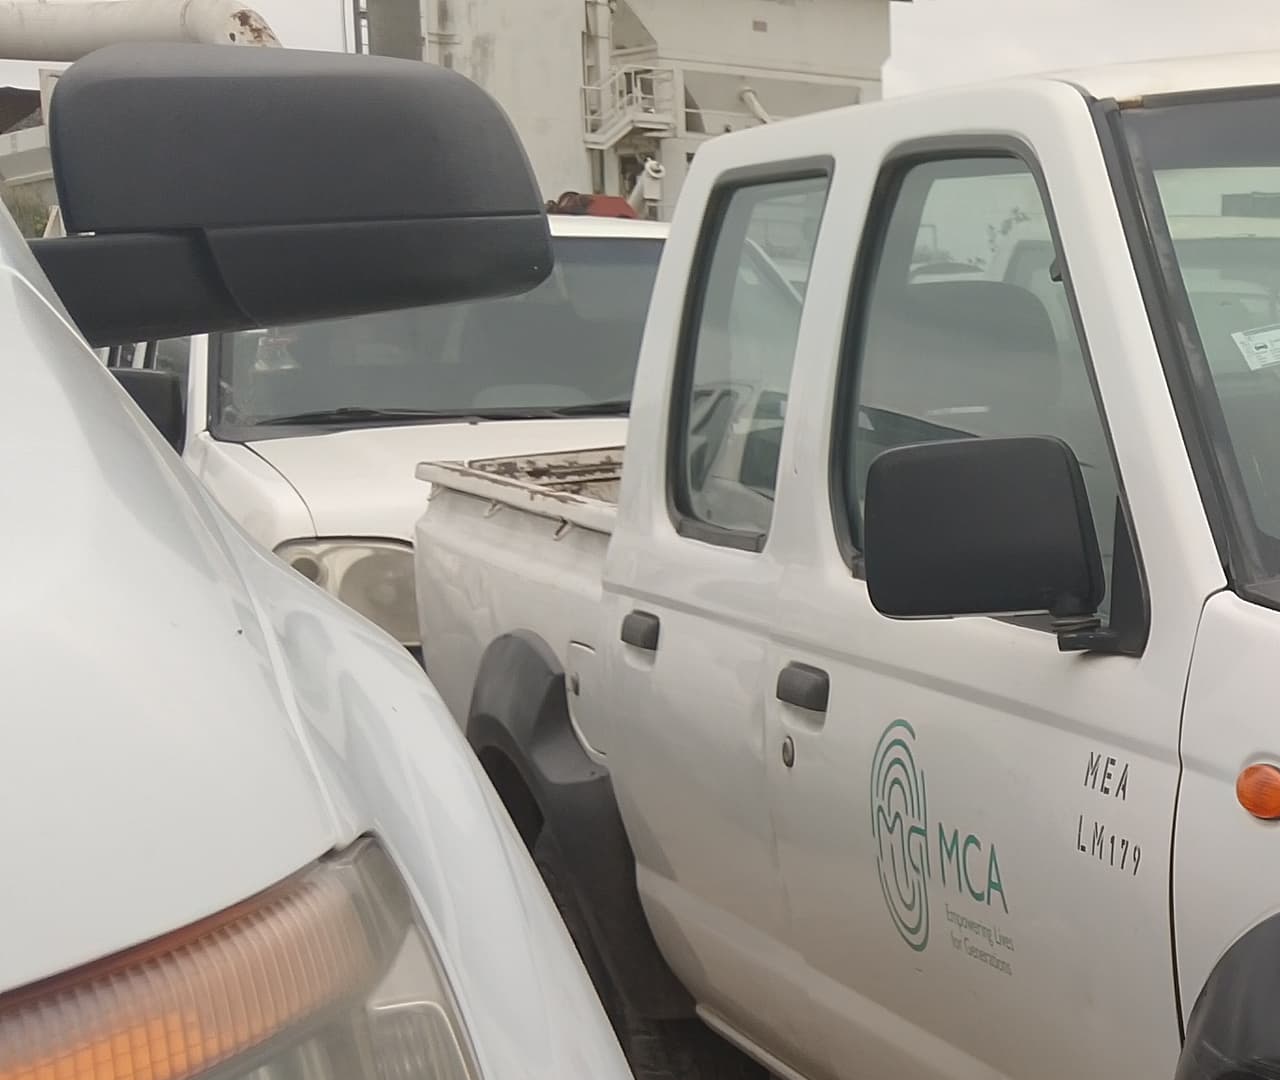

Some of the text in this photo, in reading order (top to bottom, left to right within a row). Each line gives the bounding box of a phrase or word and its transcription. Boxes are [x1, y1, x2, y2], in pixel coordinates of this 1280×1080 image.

[1083, 751, 1129, 801] MEA
[938, 822, 1009, 914] MCA
[1077, 814, 1141, 876] LM179
